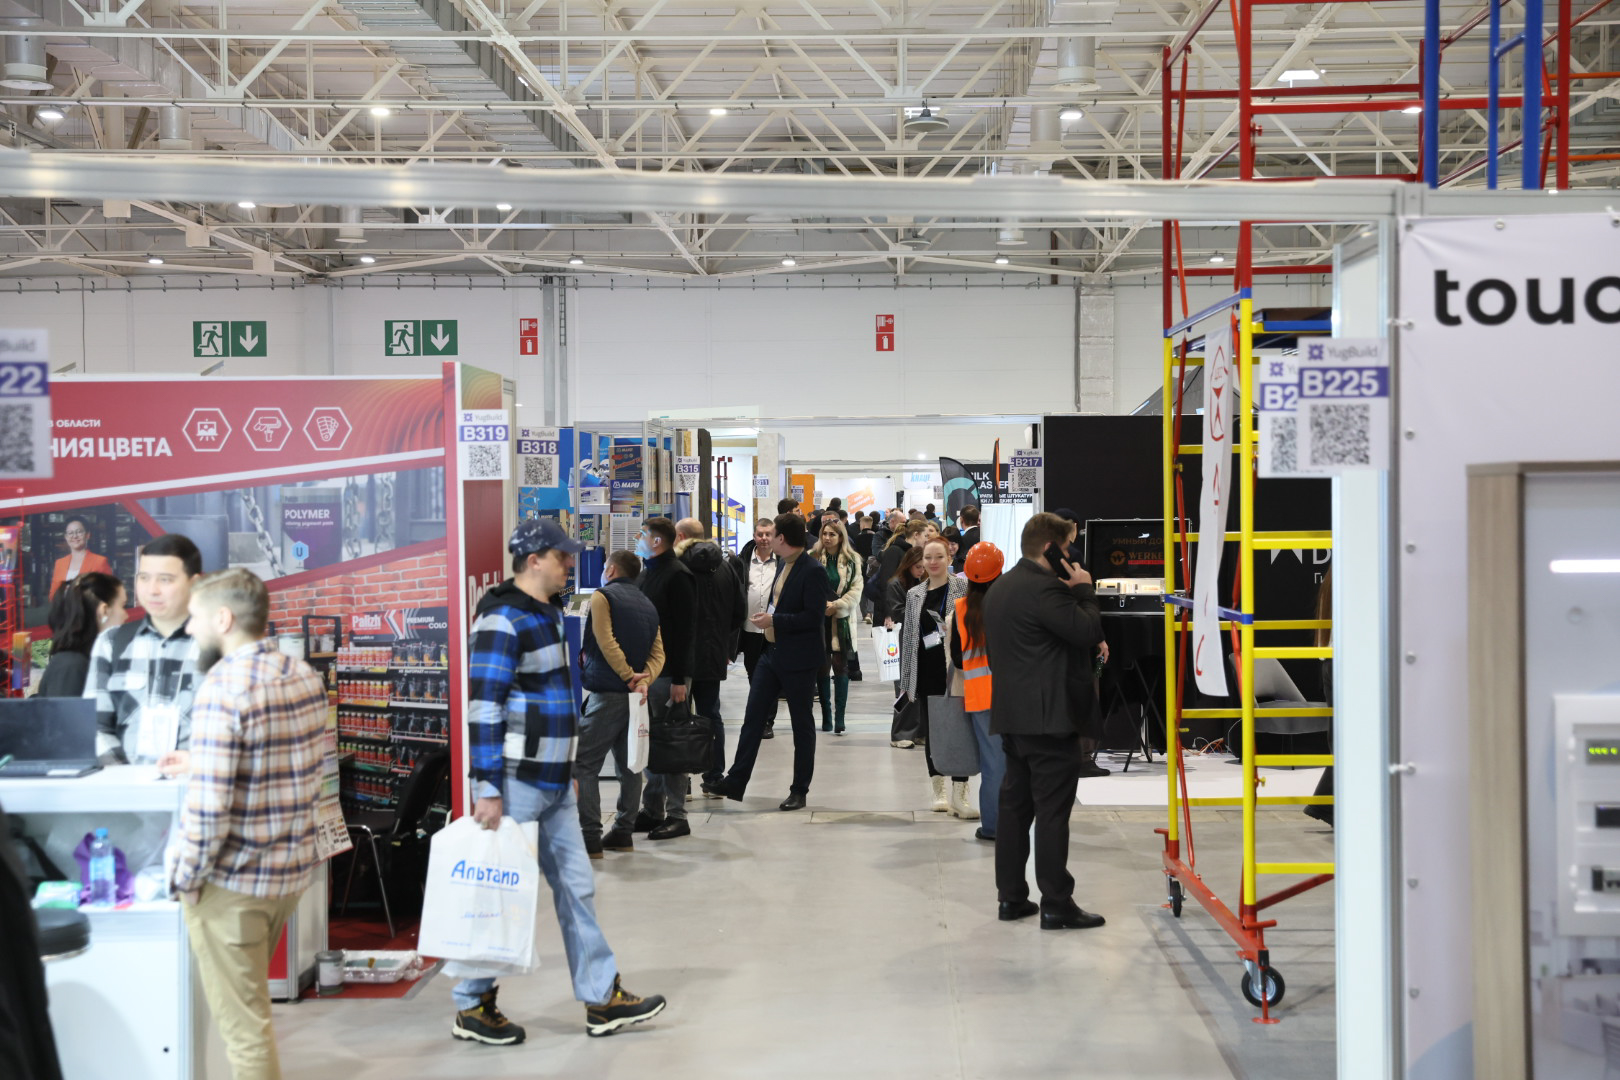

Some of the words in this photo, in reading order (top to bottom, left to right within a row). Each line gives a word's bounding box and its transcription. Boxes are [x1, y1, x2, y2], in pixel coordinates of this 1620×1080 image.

[1327, 346, 1378, 361] YugBuild
[1302, 369, 1380, 397] B225
[56, 419, 101, 428] ОБЛАСТИ
[463, 426, 506, 441] B319
[98, 437, 173, 461] ЦВЕТА
[521, 441, 557, 454] B318
[677, 464, 699, 473] B315
[1015, 458, 1039, 467] B217
[284, 509, 330, 519] POLYMER
[351, 614, 382, 629] Palizh
